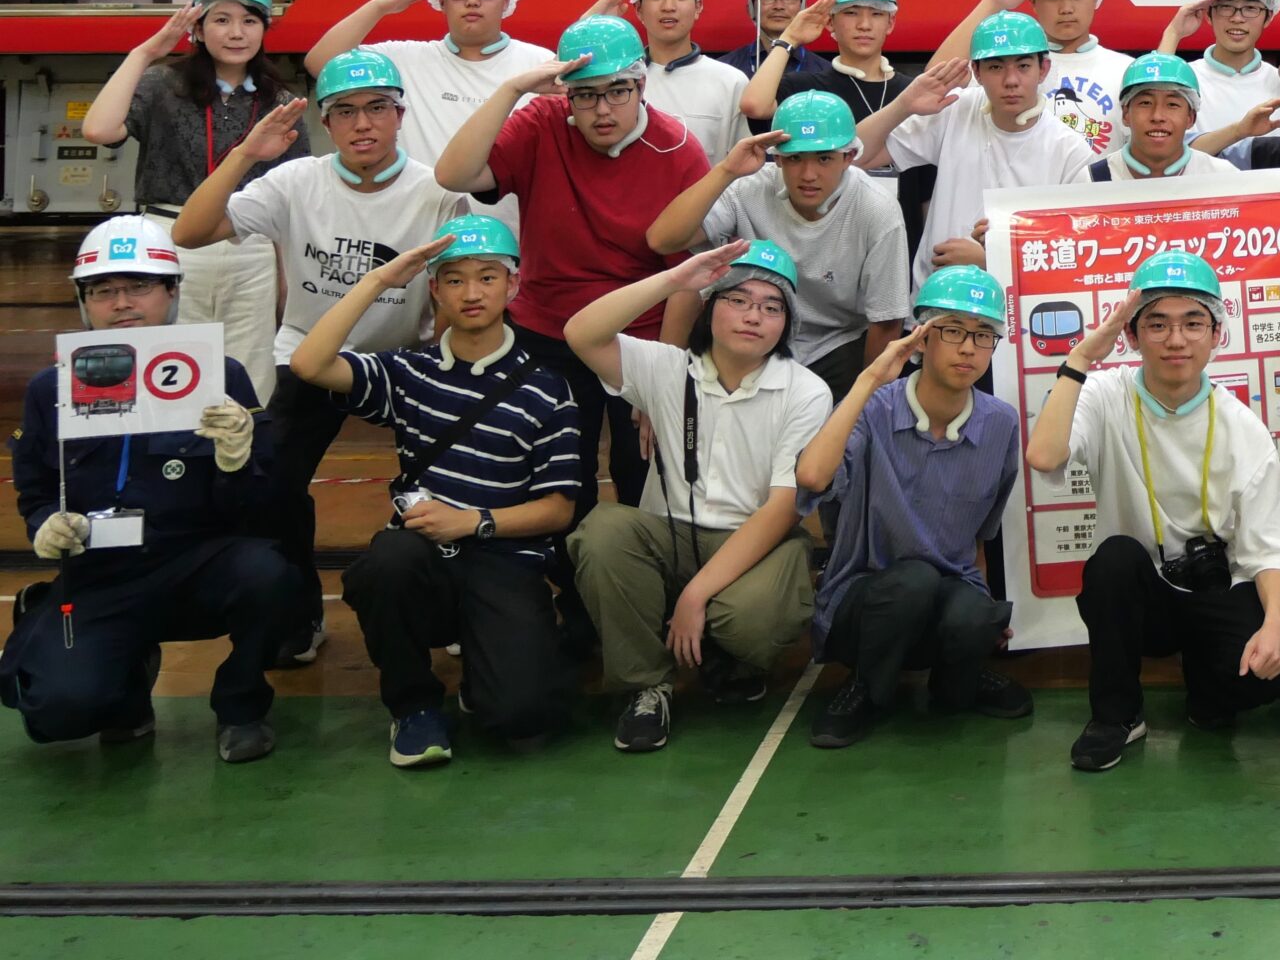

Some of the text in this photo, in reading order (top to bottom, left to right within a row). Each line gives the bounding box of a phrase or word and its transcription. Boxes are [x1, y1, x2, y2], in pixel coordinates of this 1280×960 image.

[1134, 207, 1240, 225] 東京大学生産技術研究所
[334, 237, 373, 257] THE
[304, 243, 371, 272] NORTH
[321, 288, 345, 299] ULTRA
[1008, 294, 1017, 337] Tokyo Metro
[1252, 322, 1275, 333] 中学生
